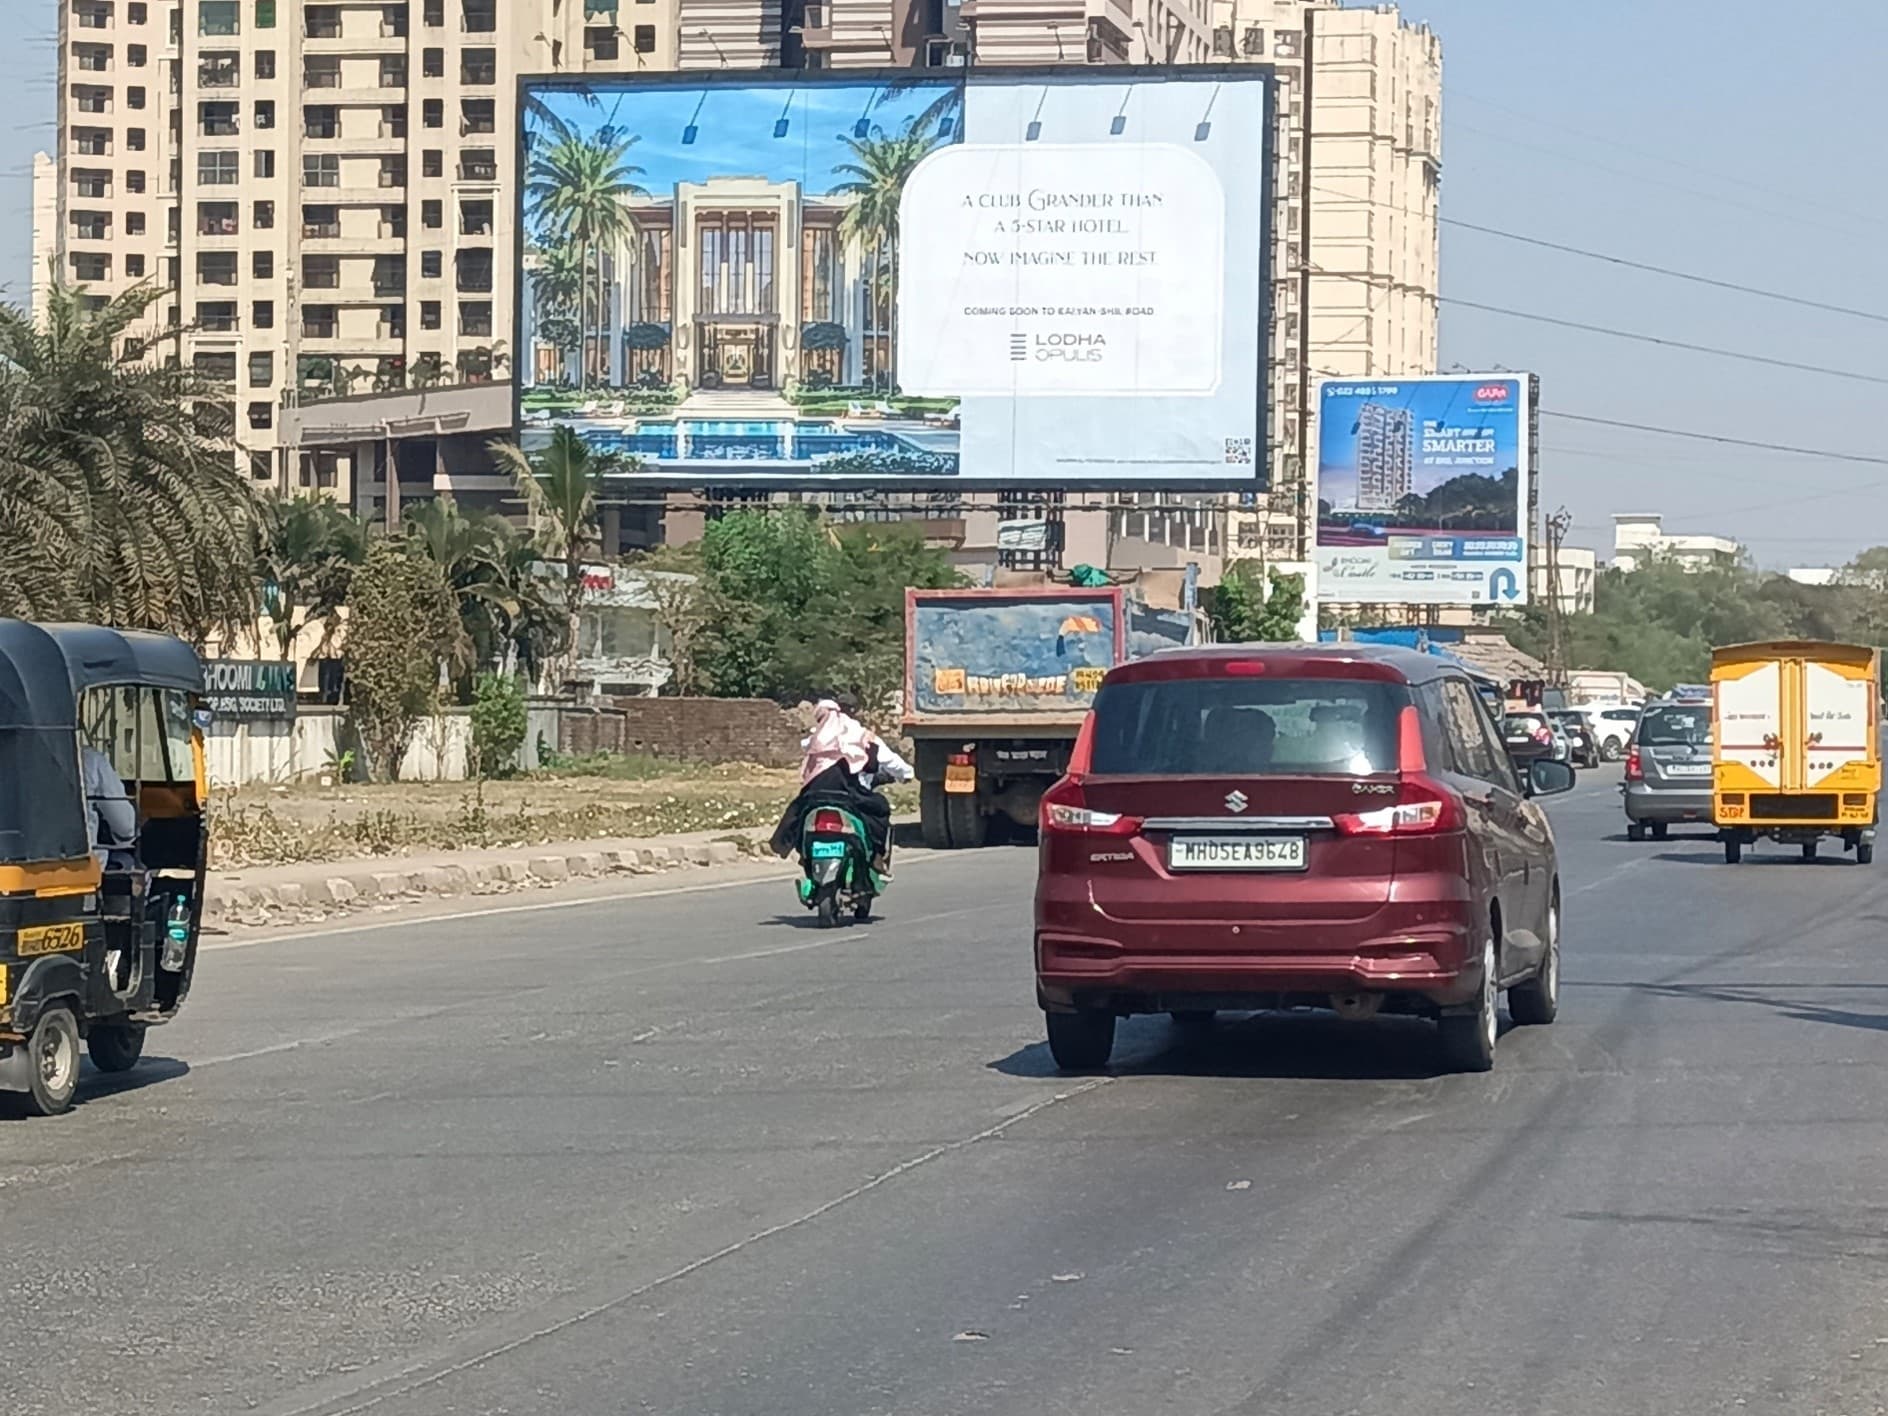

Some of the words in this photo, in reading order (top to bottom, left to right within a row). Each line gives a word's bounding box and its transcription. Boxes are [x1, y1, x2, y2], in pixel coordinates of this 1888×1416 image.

[962, 195, 973, 208] A
[978, 194, 1021, 208] CLUB
[1121, 193, 1163, 208] THAN
[994, 220, 1005, 233] A
[1012, 219, 1066, 234] 5-STAR
[963, 251, 1001, 266] NOW
[1010, 251, 1075, 266] IMAGINE
[1082, 251, 1112, 266] THE
[963, 306, 1006, 316] COMING
[1009, 306, 1038, 316] SOON
[1042, 307, 1055, 316] TO
[1125, 307, 1154, 316] ROAD
[1035, 333, 1107, 346] LODHA
[1422, 439, 1496, 453] SMARTER
